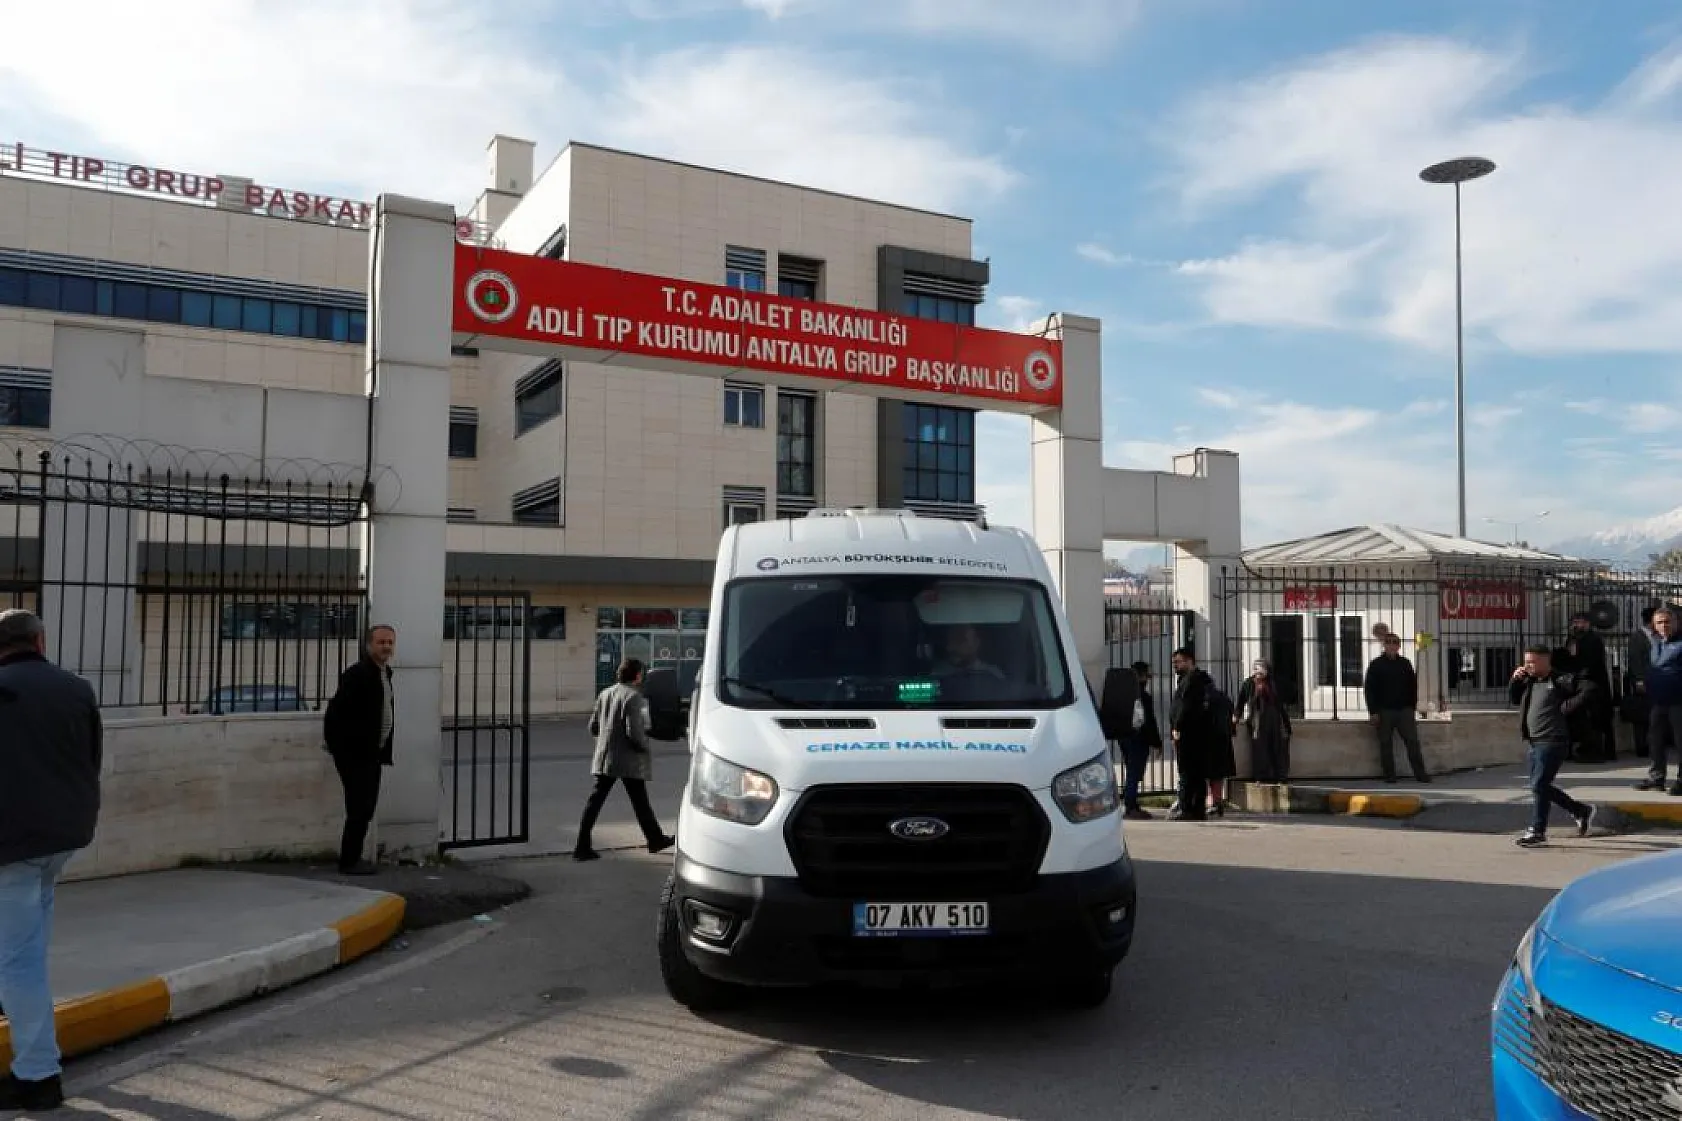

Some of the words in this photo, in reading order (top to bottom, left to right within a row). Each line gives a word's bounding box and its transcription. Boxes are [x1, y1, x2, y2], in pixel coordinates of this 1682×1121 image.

[47, 152, 105, 181] TIP
[126, 165, 224, 200] GRUP
[661, 286, 703, 316] T.C.
[708, 294, 794, 329] ADALET
[800, 307, 908, 347] BAKANLIĞI
[526, 304, 584, 338] ADLİ
[593, 314, 633, 343] TIP
[638, 321, 740, 358] KURUMU
[746, 336, 838, 371] ANTALYA
[844, 350, 897, 377] GRUP
[906, 357, 1020, 393] BAŞKANLIĞI
[781, 555, 840, 565] ANTALYA
[806, 741, 891, 752] CENAZE
[896, 739, 959, 750] NAKİL
[965, 741, 1026, 753] ARACI
[902, 821, 936, 836] Ford
[867, 904, 891, 927] 07
[901, 904, 936, 928] AKV
[948, 904, 985, 927] 510
